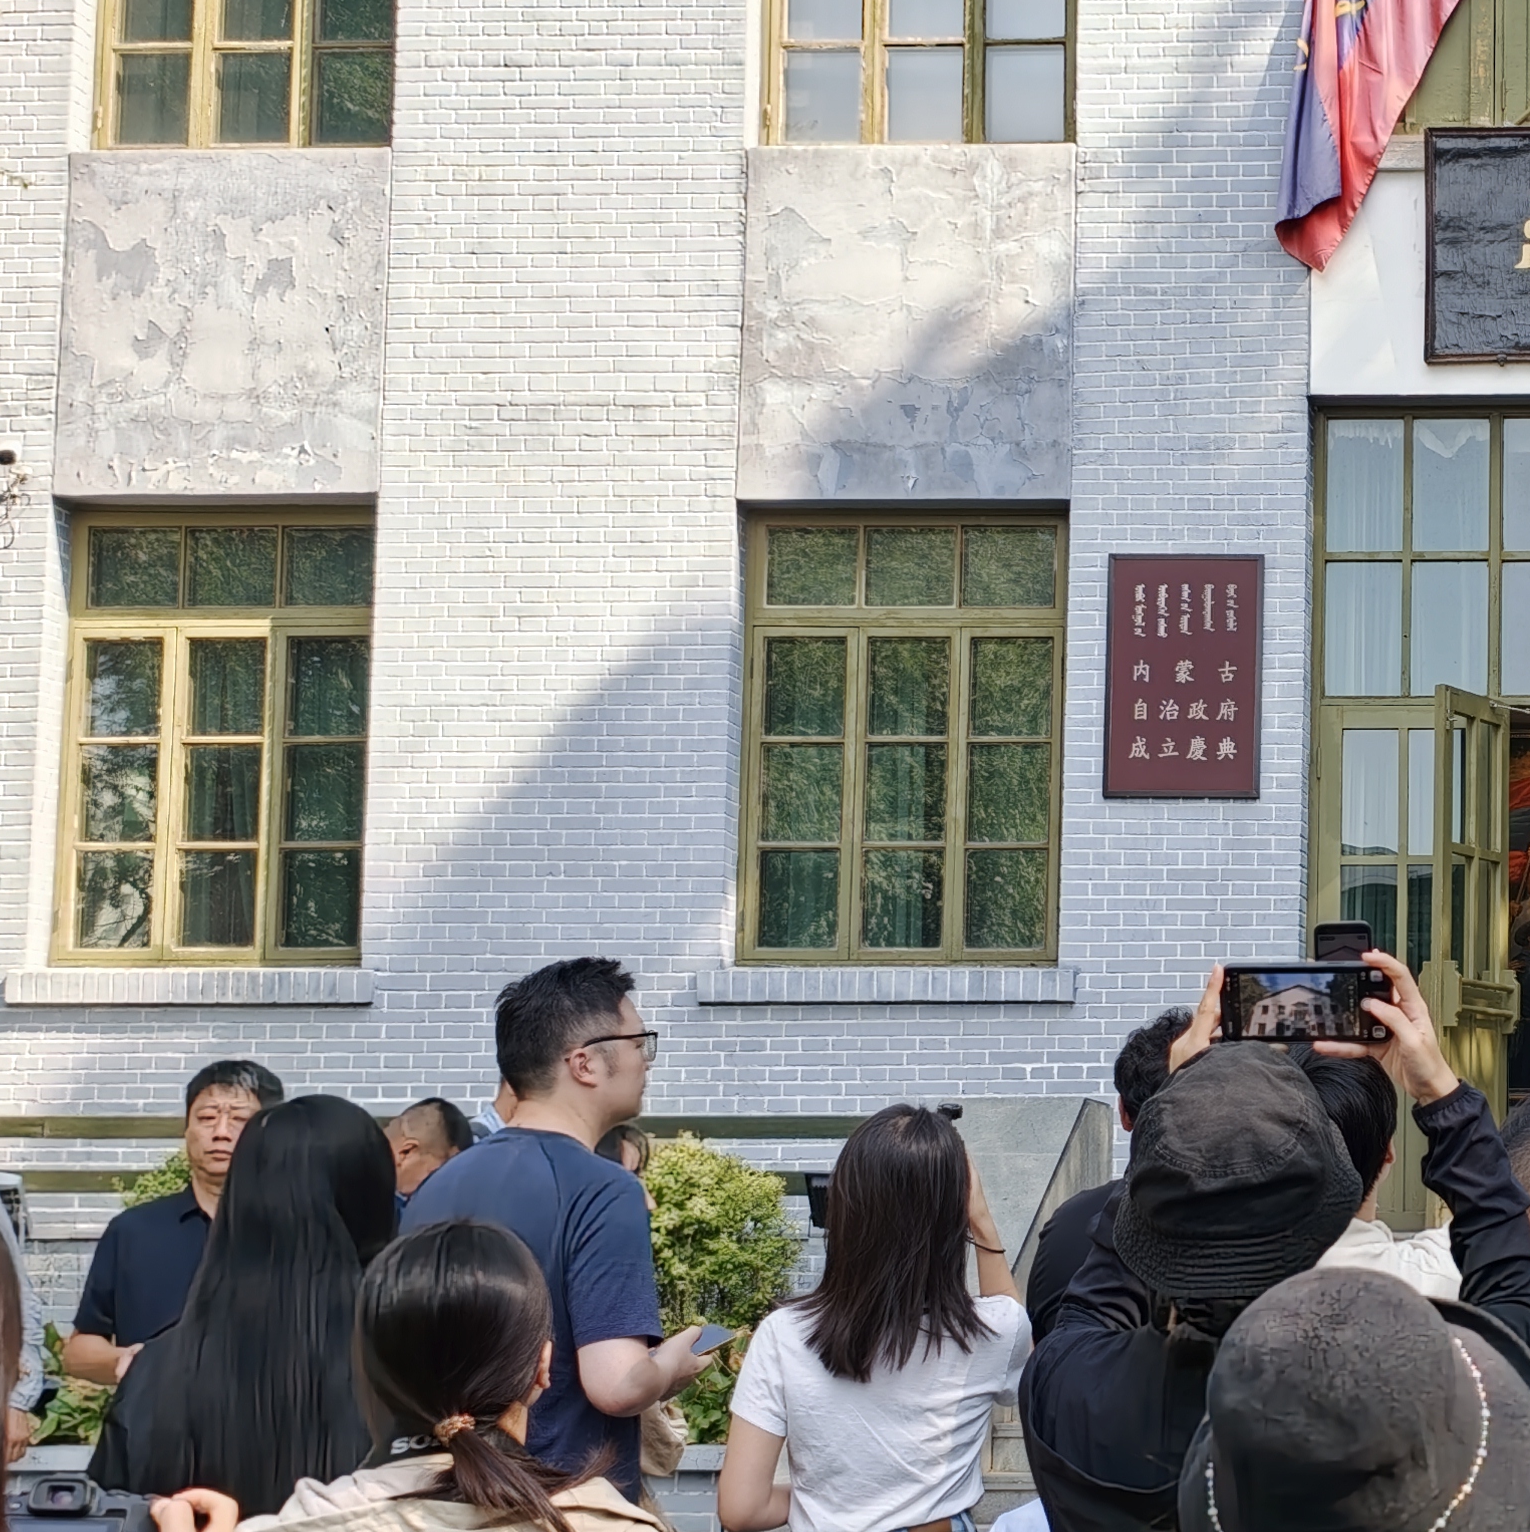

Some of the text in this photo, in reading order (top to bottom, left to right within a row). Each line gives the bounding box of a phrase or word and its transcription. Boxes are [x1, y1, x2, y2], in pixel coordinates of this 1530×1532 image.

[1133, 660, 1238, 683] 内蒙古
[1133, 698, 1238, 721] 自治政府
[1129, 736, 1237, 760] 成立慶典
[390, 1434, 441, 1455] SO
